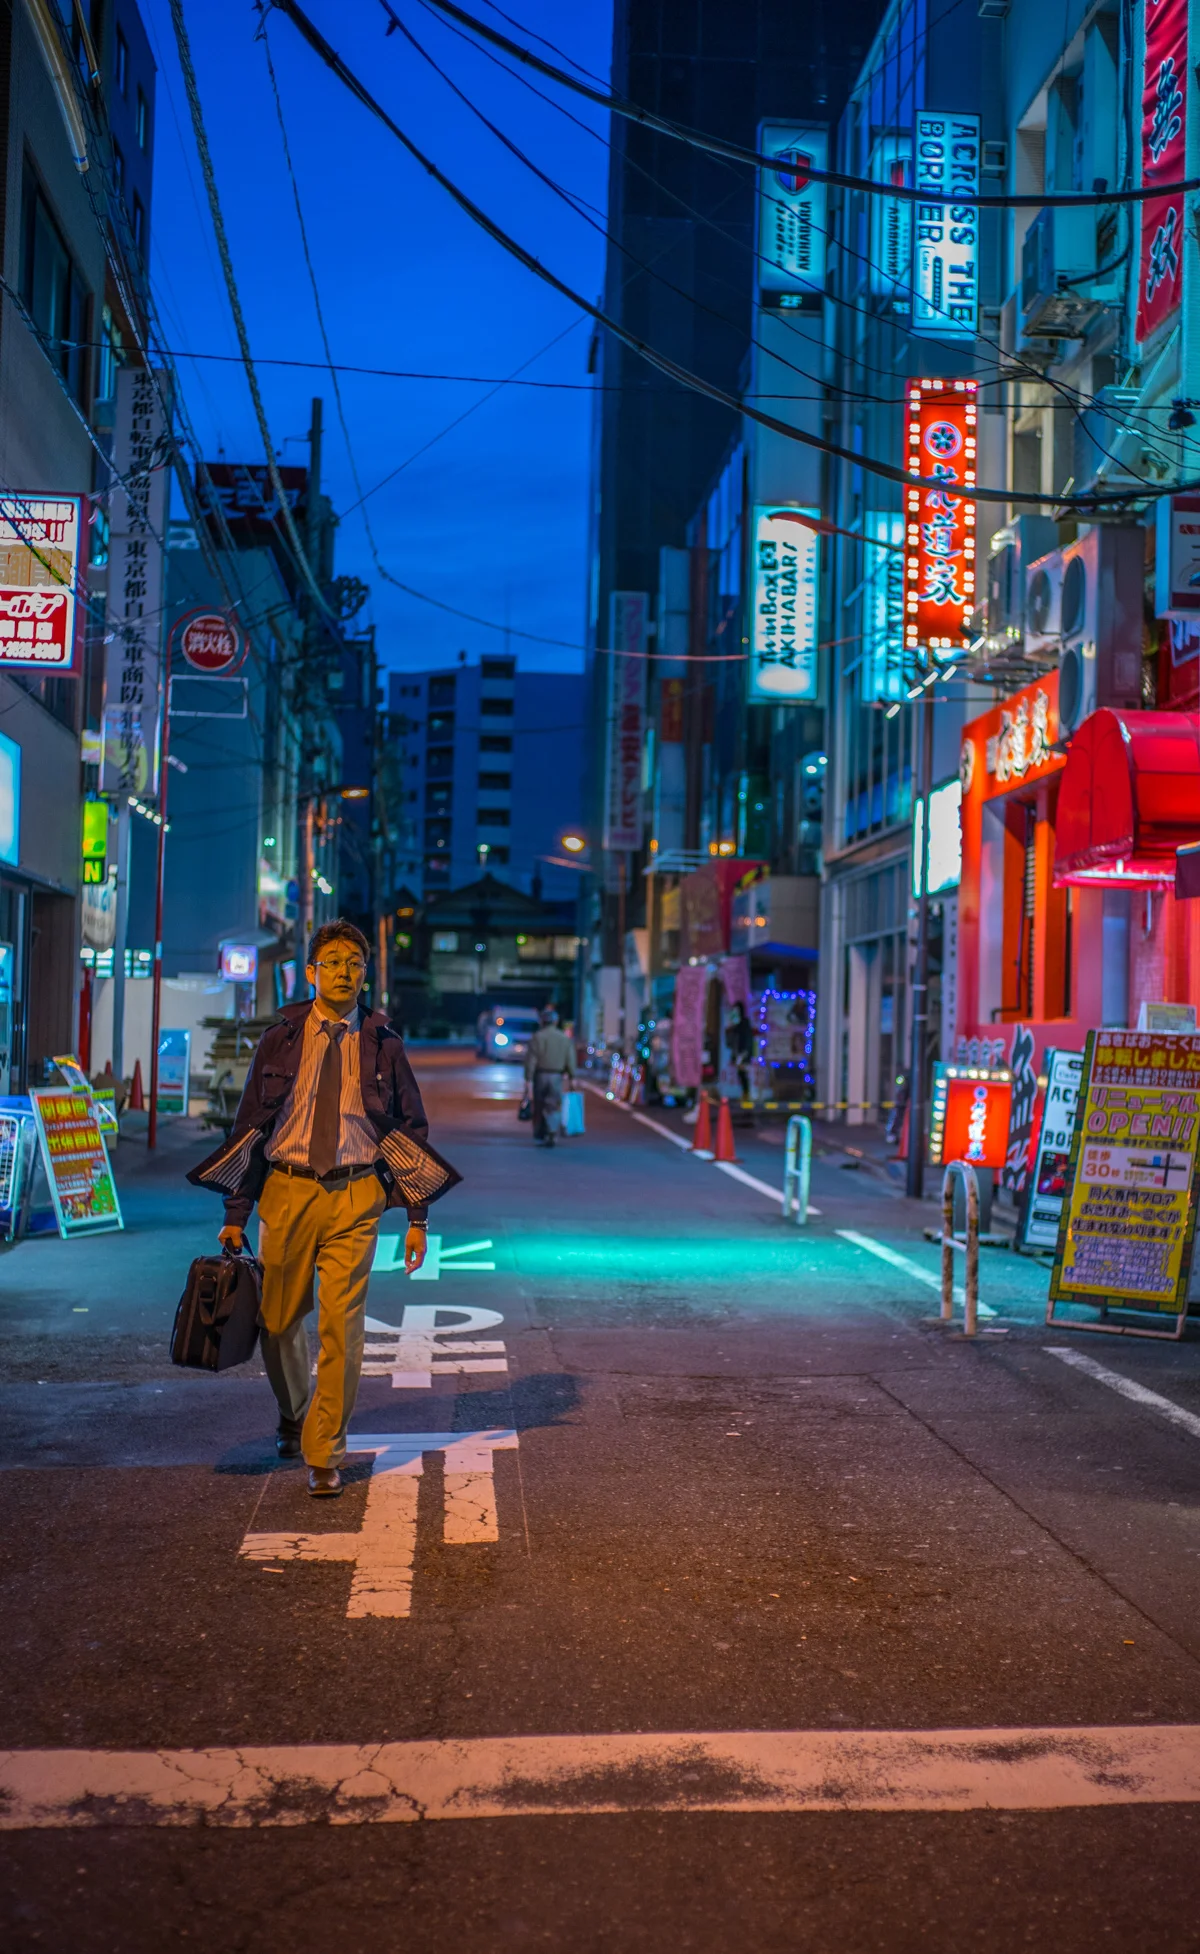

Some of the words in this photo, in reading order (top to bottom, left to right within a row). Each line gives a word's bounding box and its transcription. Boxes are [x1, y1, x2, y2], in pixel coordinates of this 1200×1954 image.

[798, 201, 811, 271] AKIHABARA
[948, 261, 975, 322] THE
[127, 371, 154, 534] 東京都自転車協同組合
[187, 631, 233, 656] 消火栓
[1091, 1087, 1198, 1114] リニューアル
